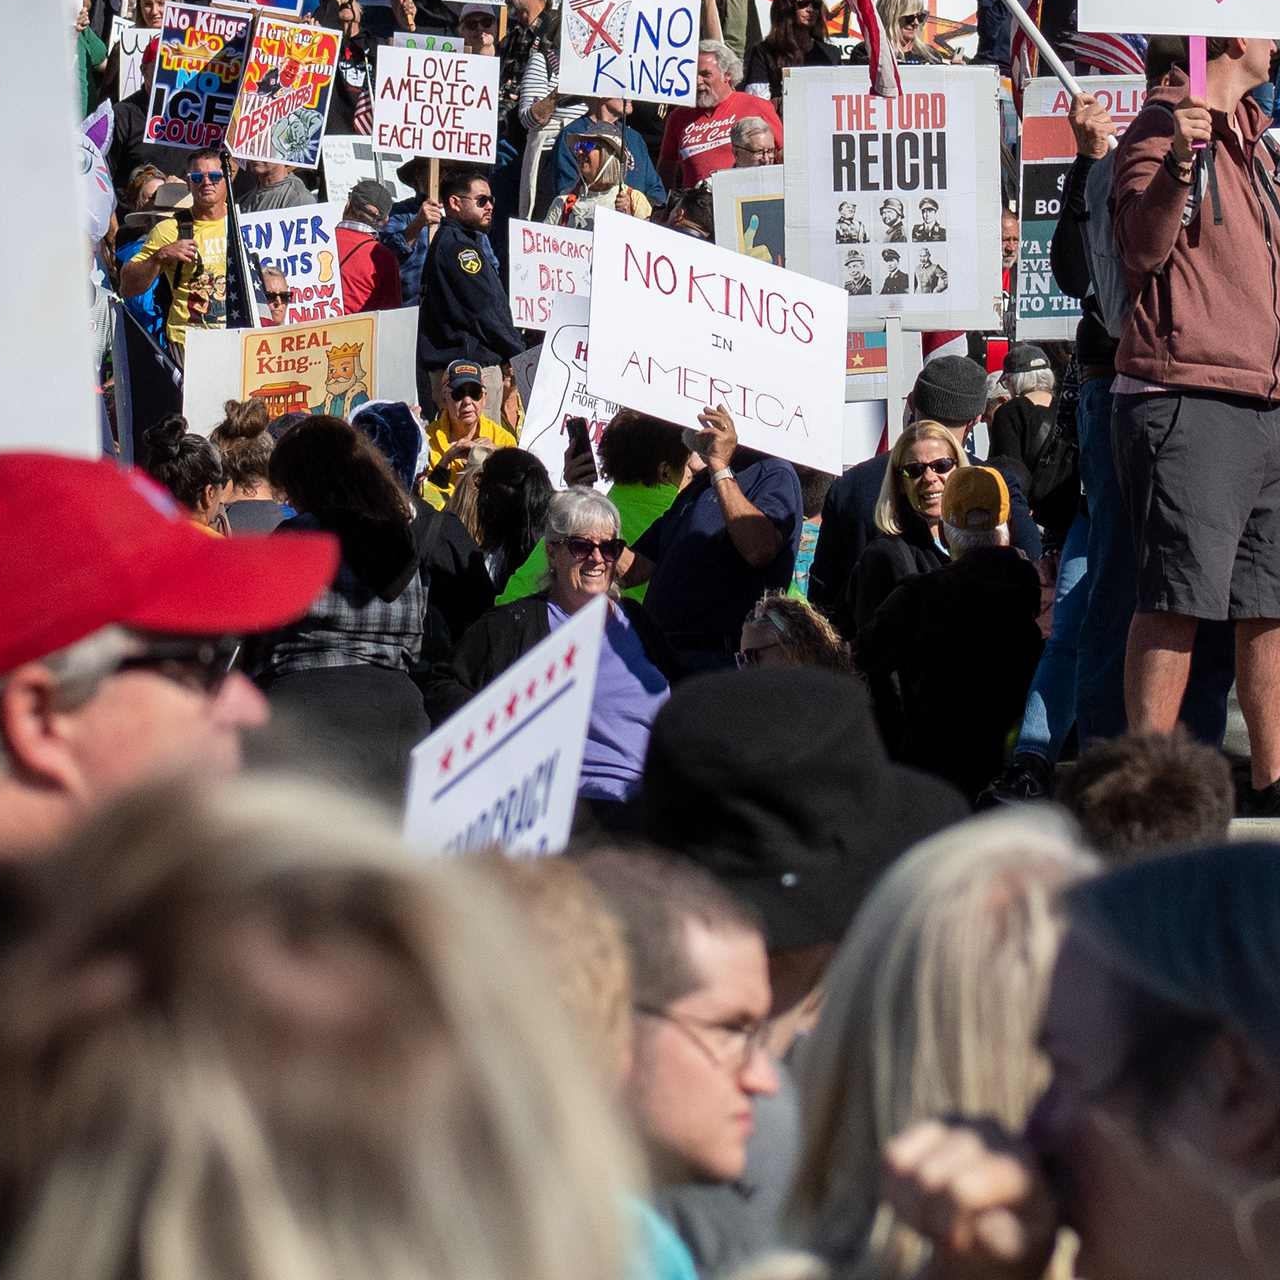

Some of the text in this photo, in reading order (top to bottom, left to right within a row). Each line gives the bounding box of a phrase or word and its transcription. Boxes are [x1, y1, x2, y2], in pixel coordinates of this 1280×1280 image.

[195, 14, 247, 41] Kings
[634, 7, 692, 53] NO
[407, 56, 468, 82] LOVE
[152, 87, 234, 126] ICE
[381, 77, 492, 110] AMERICA
[404, 103, 465, 129] LOVE
[685, 114, 735, 134] Original
[832, 93, 946, 131] THE TURD
[379, 124, 491, 156] EACH OTHER
[833, 132, 947, 192] REICH
[280, 216, 330, 252] YER
[624, 243, 814, 344] NO KINGS
[256, 331, 332, 355] A REAL
[712, 334, 732, 352] IN
[622, 351, 809, 438] AMERICA
